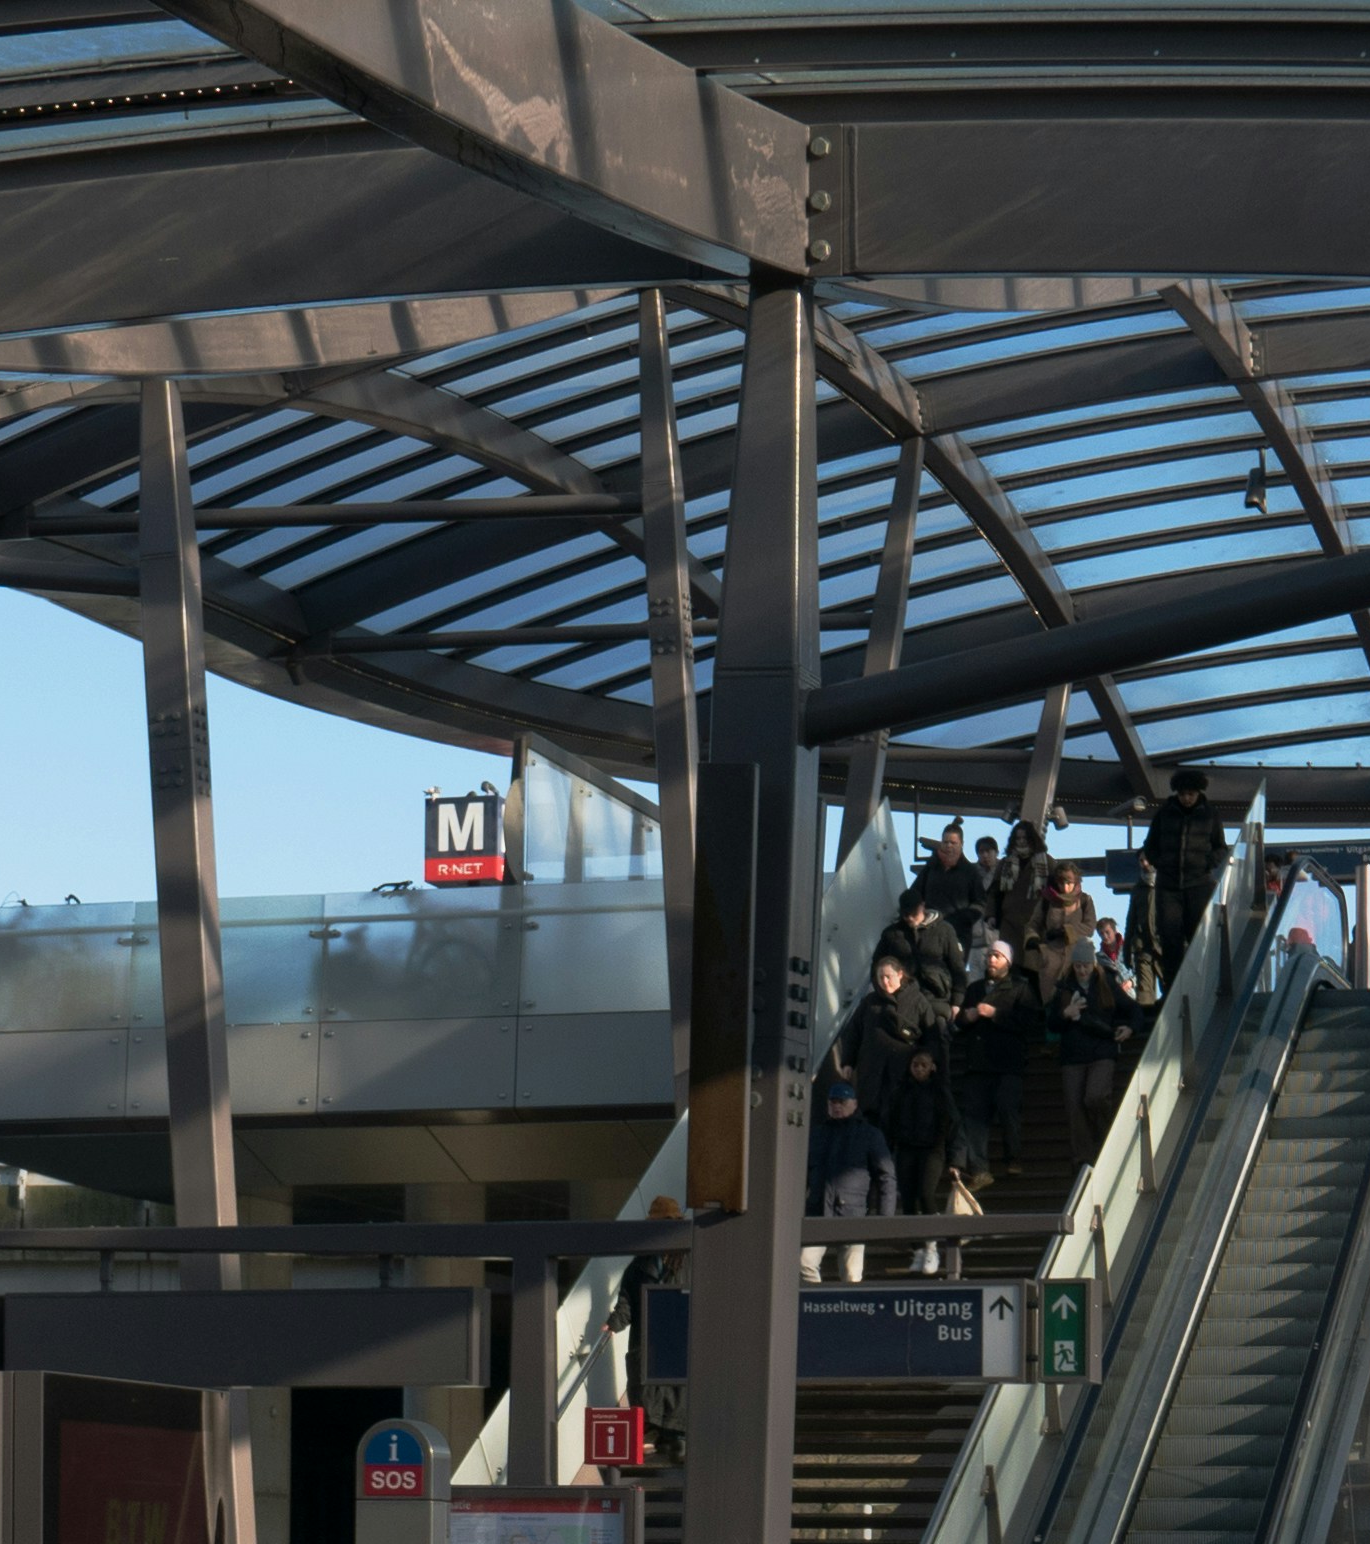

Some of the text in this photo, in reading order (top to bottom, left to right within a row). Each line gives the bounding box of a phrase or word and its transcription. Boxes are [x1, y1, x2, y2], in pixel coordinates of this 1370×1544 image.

[437, 801, 484, 852] M
[803, 1298, 973, 1321] Hasseltweg Uitgang
[937, 1324, 973, 1341] Bus
[371, 1470, 417, 1490] SOS
